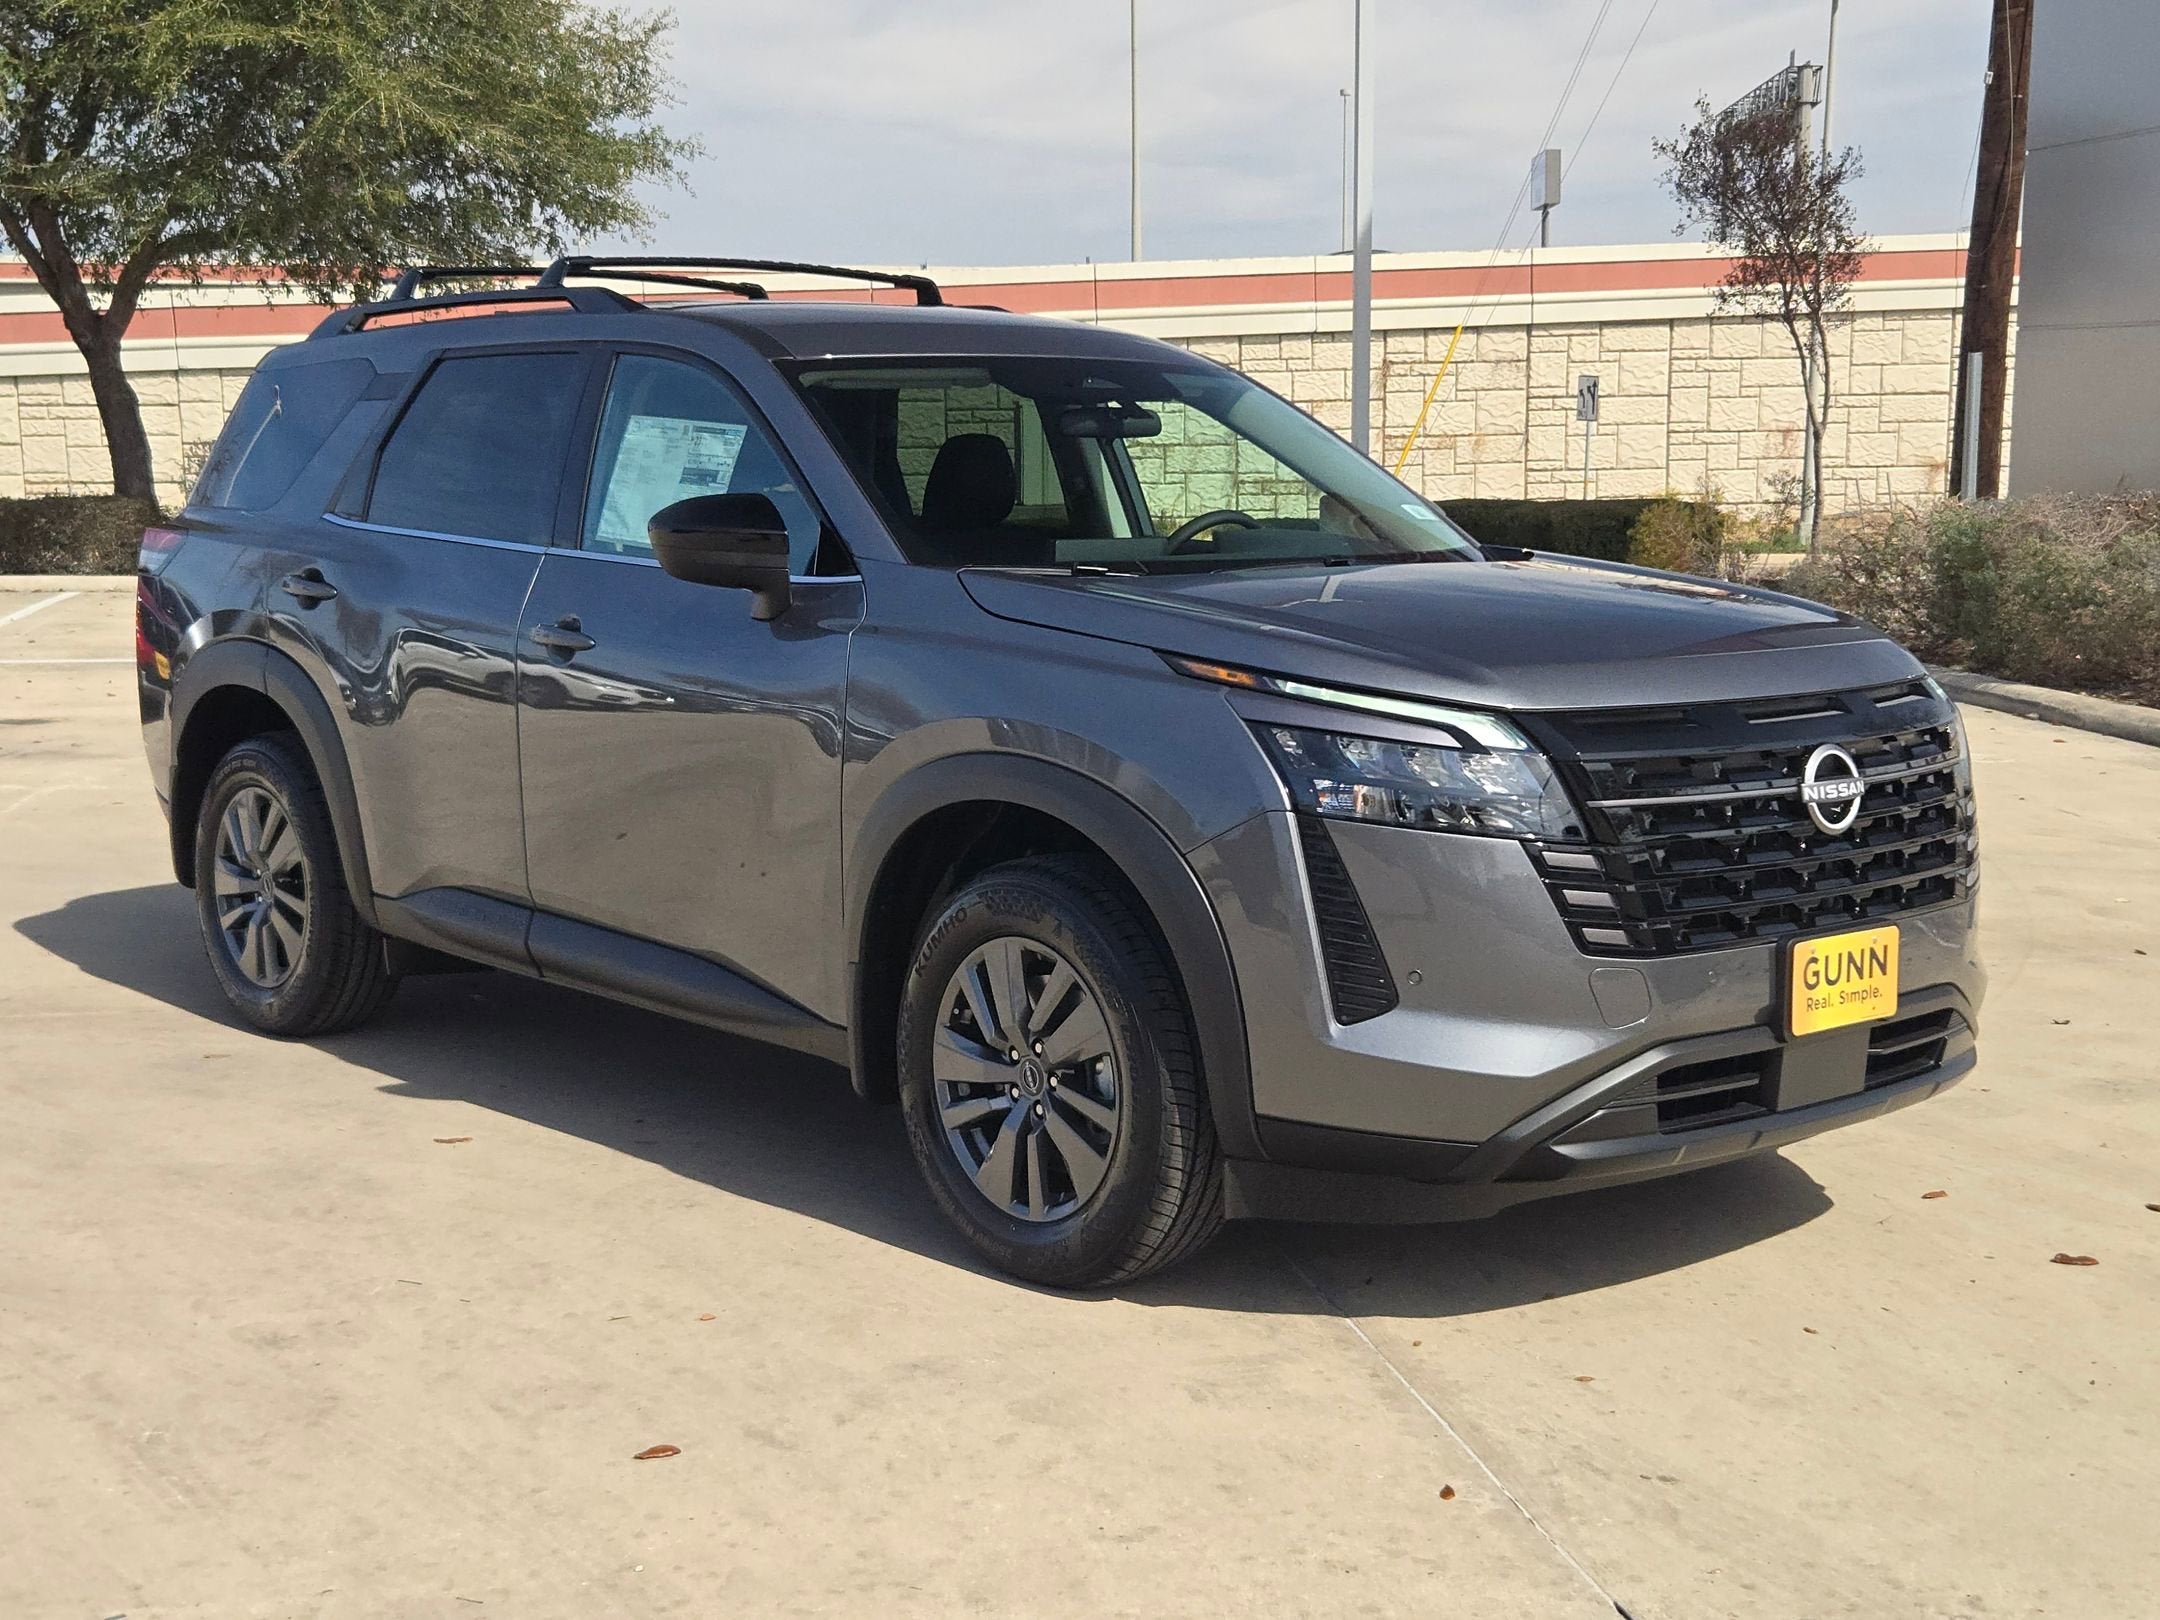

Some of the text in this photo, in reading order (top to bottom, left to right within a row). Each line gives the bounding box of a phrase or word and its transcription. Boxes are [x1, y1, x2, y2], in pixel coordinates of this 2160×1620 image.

[1803, 780, 1865, 801] NISSAN
[914, 907, 968, 978] KUMHO
[1803, 944, 1889, 991] GUNN
[1806, 984, 1883, 1012] Real. Simple.
